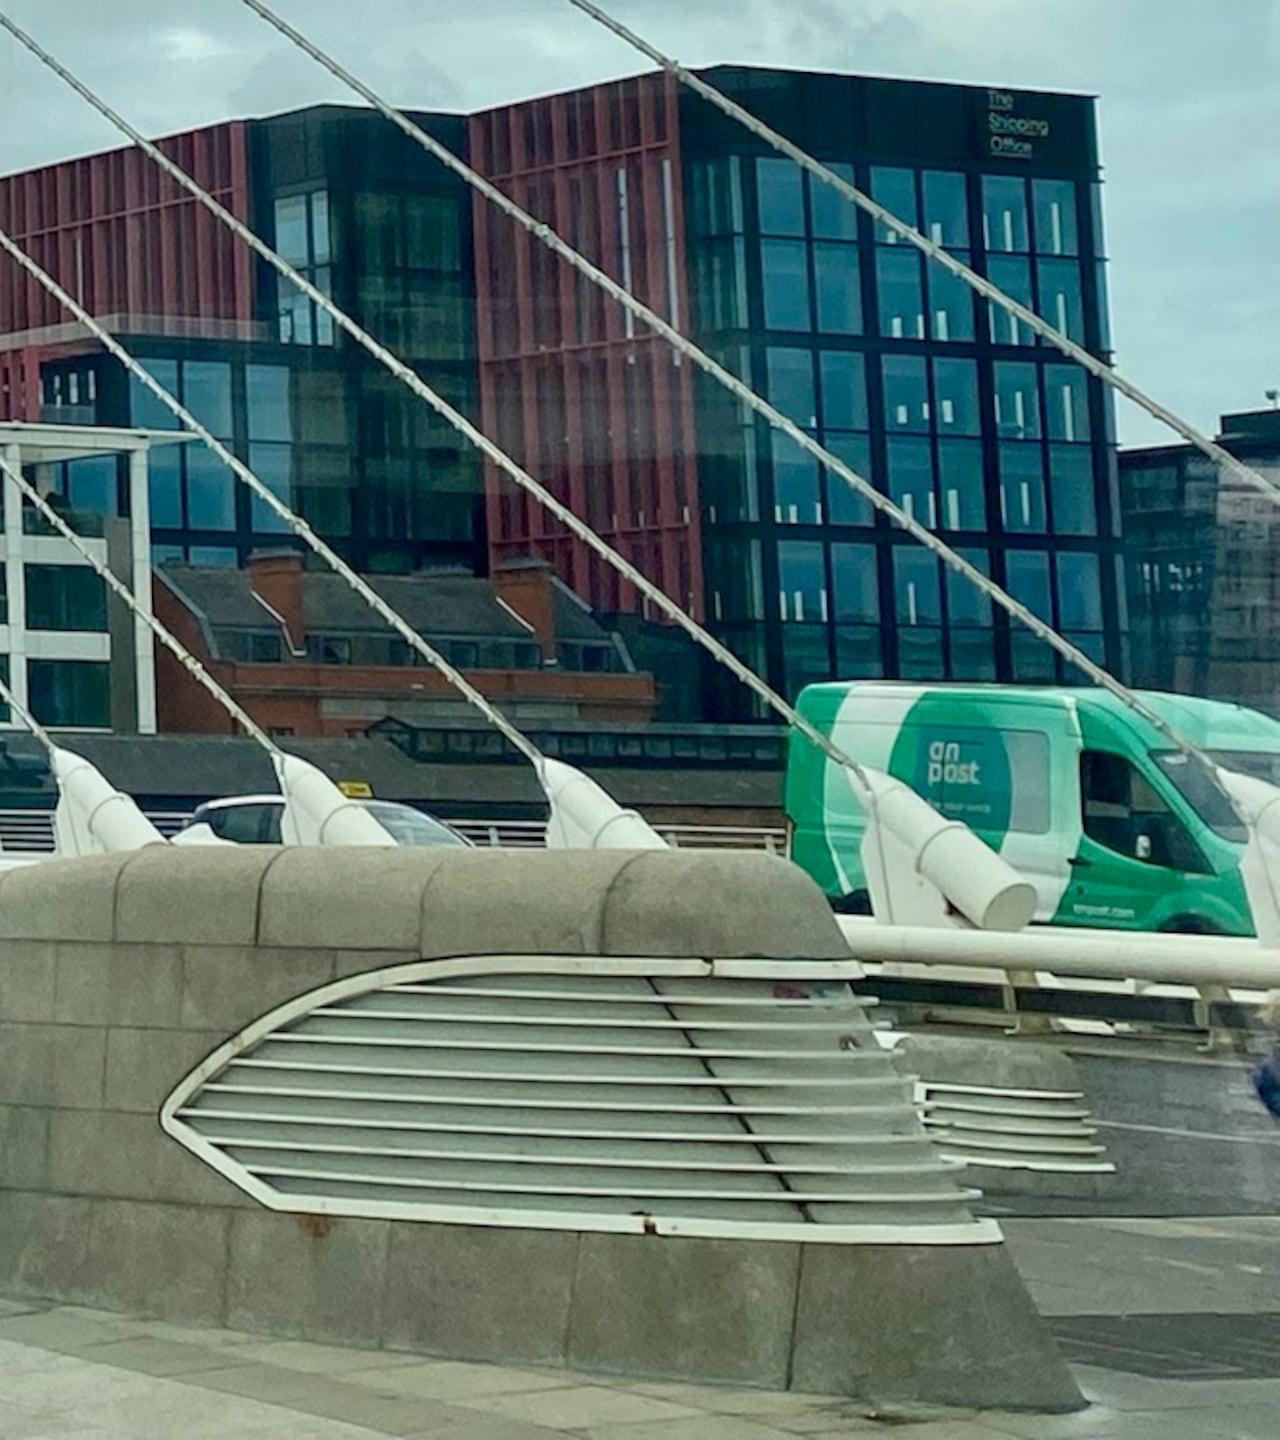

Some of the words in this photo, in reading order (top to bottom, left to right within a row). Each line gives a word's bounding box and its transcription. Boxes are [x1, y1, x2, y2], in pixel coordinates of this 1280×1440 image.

[987, 90, 1014, 109] The
[990, 136, 1033, 154] Office
[929, 741, 959, 762] an
[928, 760, 981, 787] post
